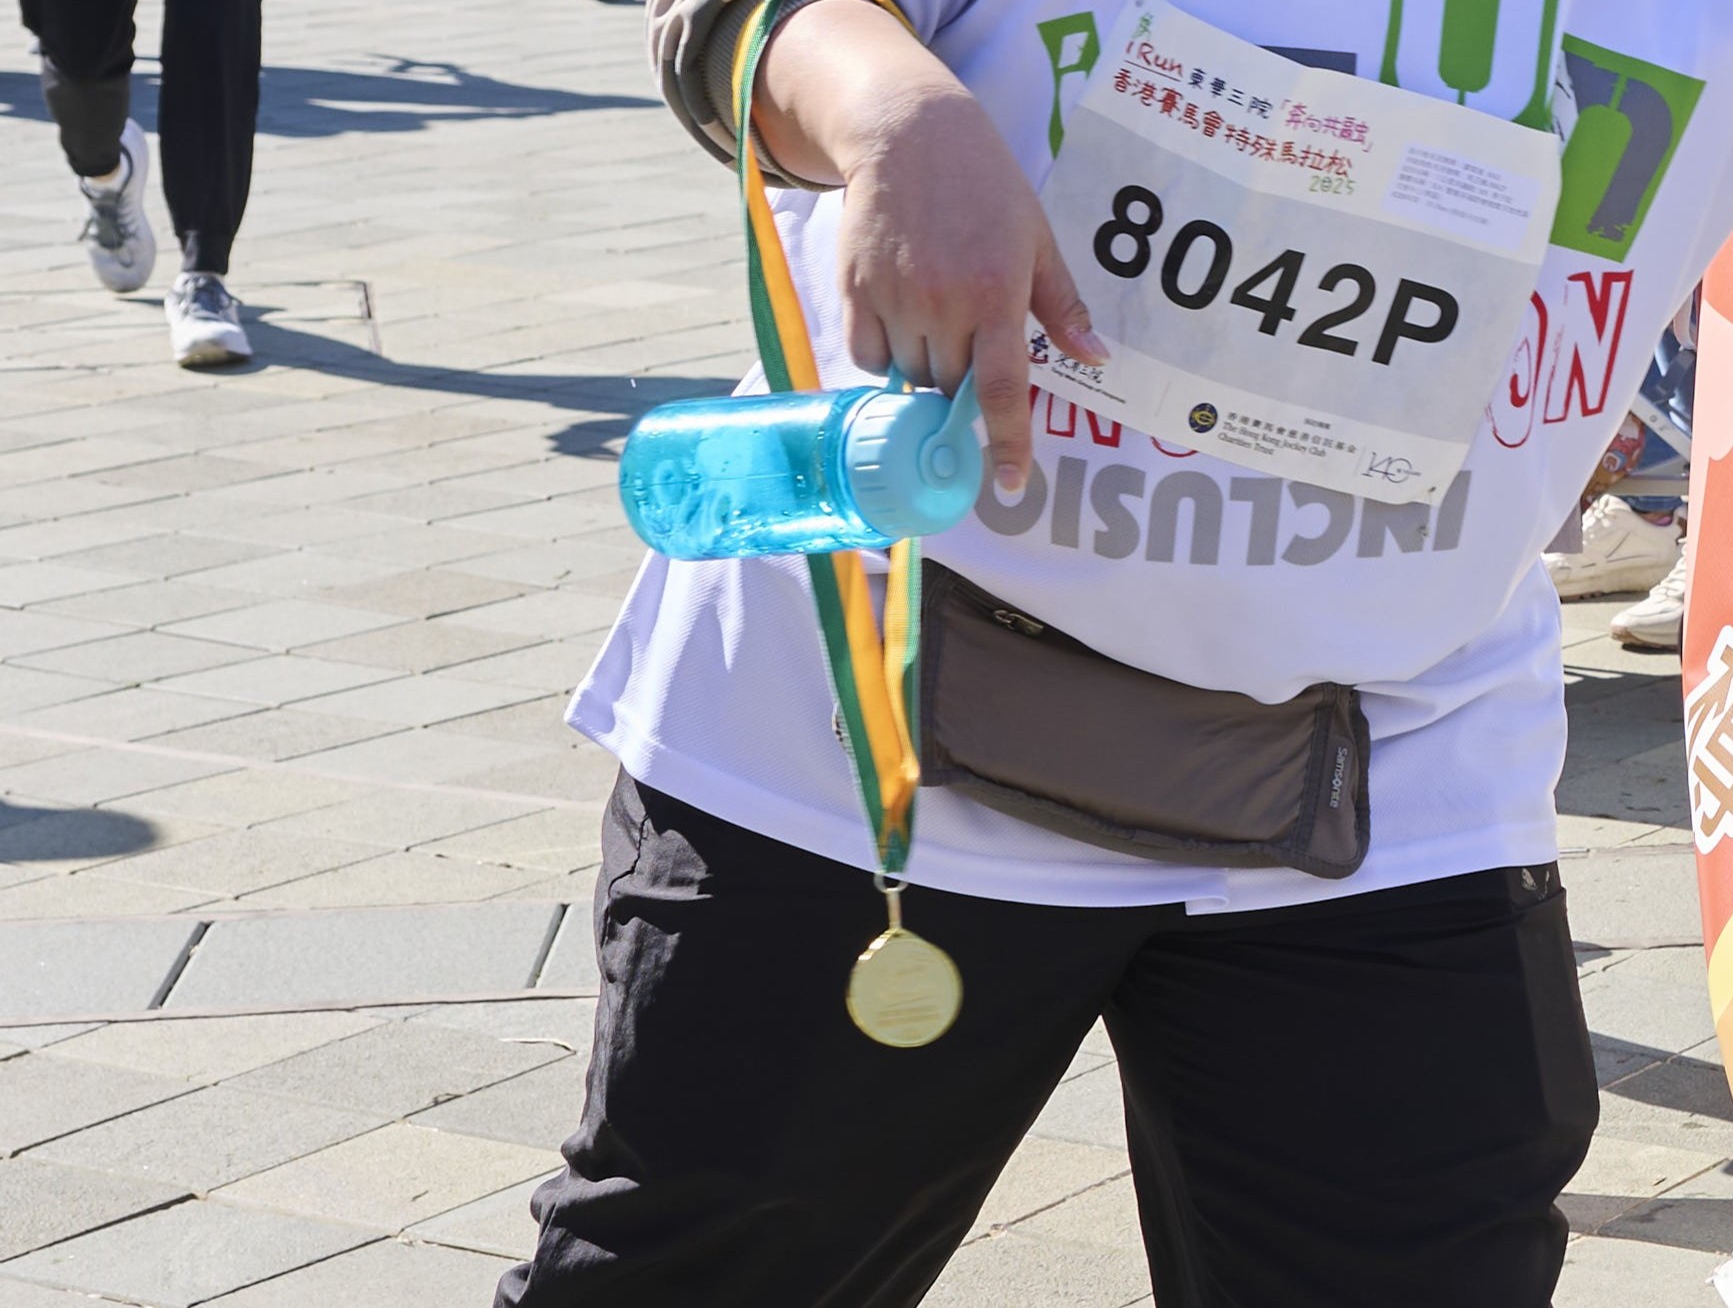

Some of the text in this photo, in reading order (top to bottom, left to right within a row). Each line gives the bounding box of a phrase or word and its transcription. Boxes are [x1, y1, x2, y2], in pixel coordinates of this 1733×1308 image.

[1112, 67, 1353, 178] 香港賽馬會特殊馬拉松
[1187, 68, 1273, 120] 東華三院
[1308, 176, 1356, 196] 2025
[1092, 184, 1461, 367] 8042P
[1329, 746, 1348, 809] Samsonite
